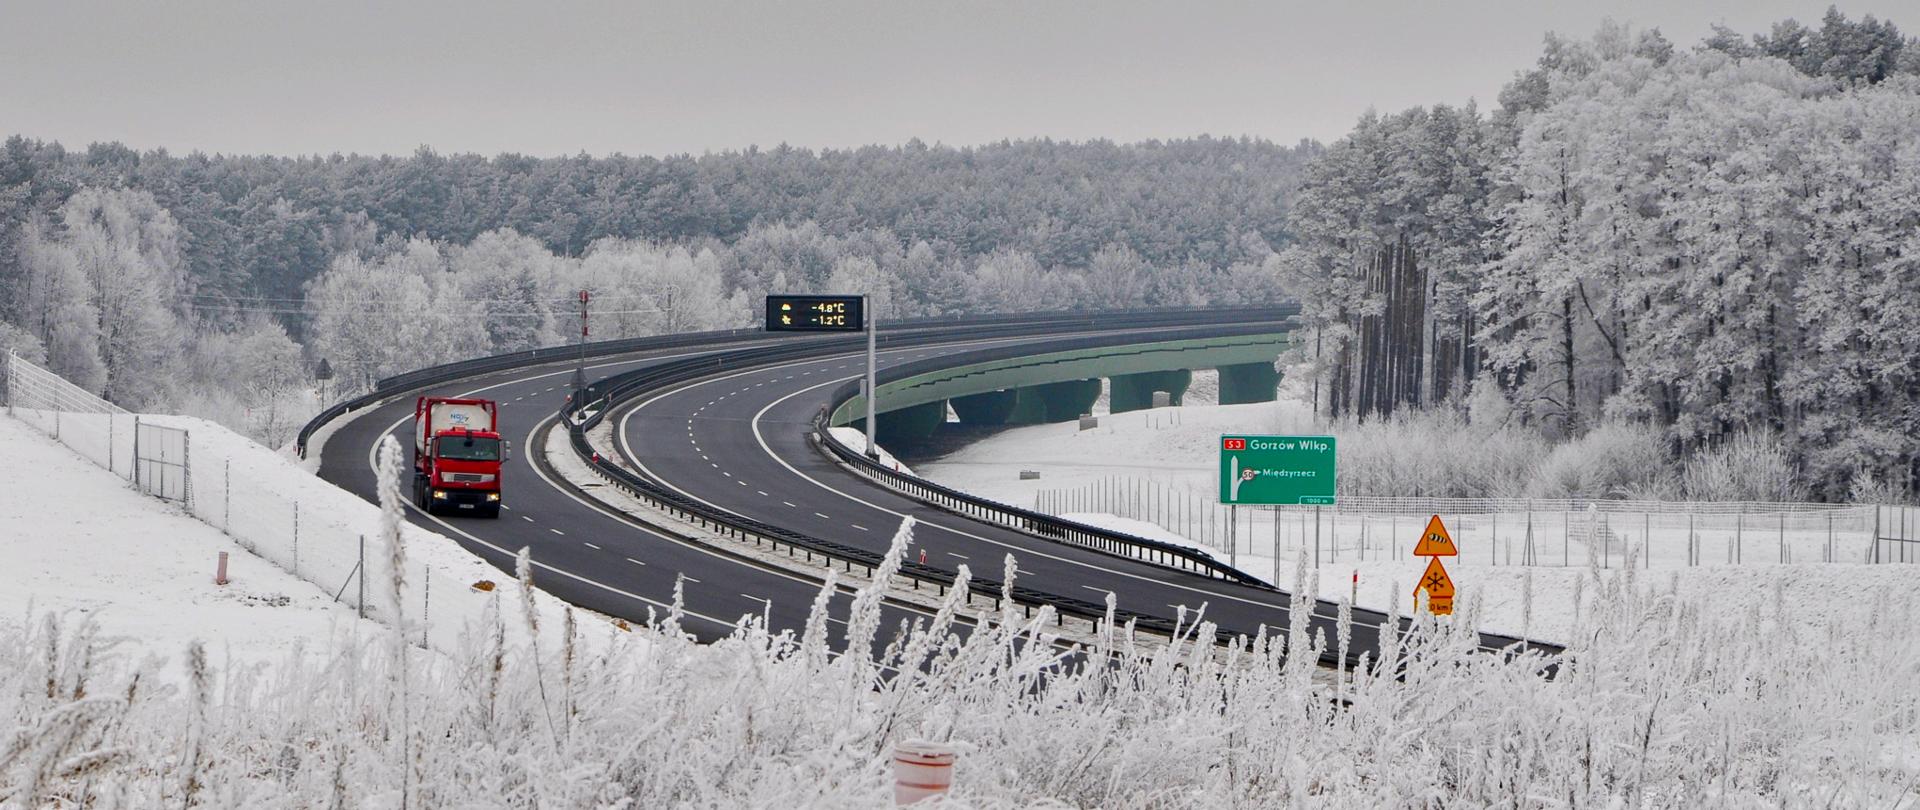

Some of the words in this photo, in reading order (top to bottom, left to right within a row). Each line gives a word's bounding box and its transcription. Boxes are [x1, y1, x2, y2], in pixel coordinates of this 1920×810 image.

[811, 303, 845, 313] -4.8°C
[811, 315, 845, 325] -1.2°C
[1250, 439, 1295, 450] Gorzów
[1299, 440, 1331, 454] Wlkp.
[1262, 469, 1316, 478] Międzyrzecz
[1437, 603, 1449, 611] km
